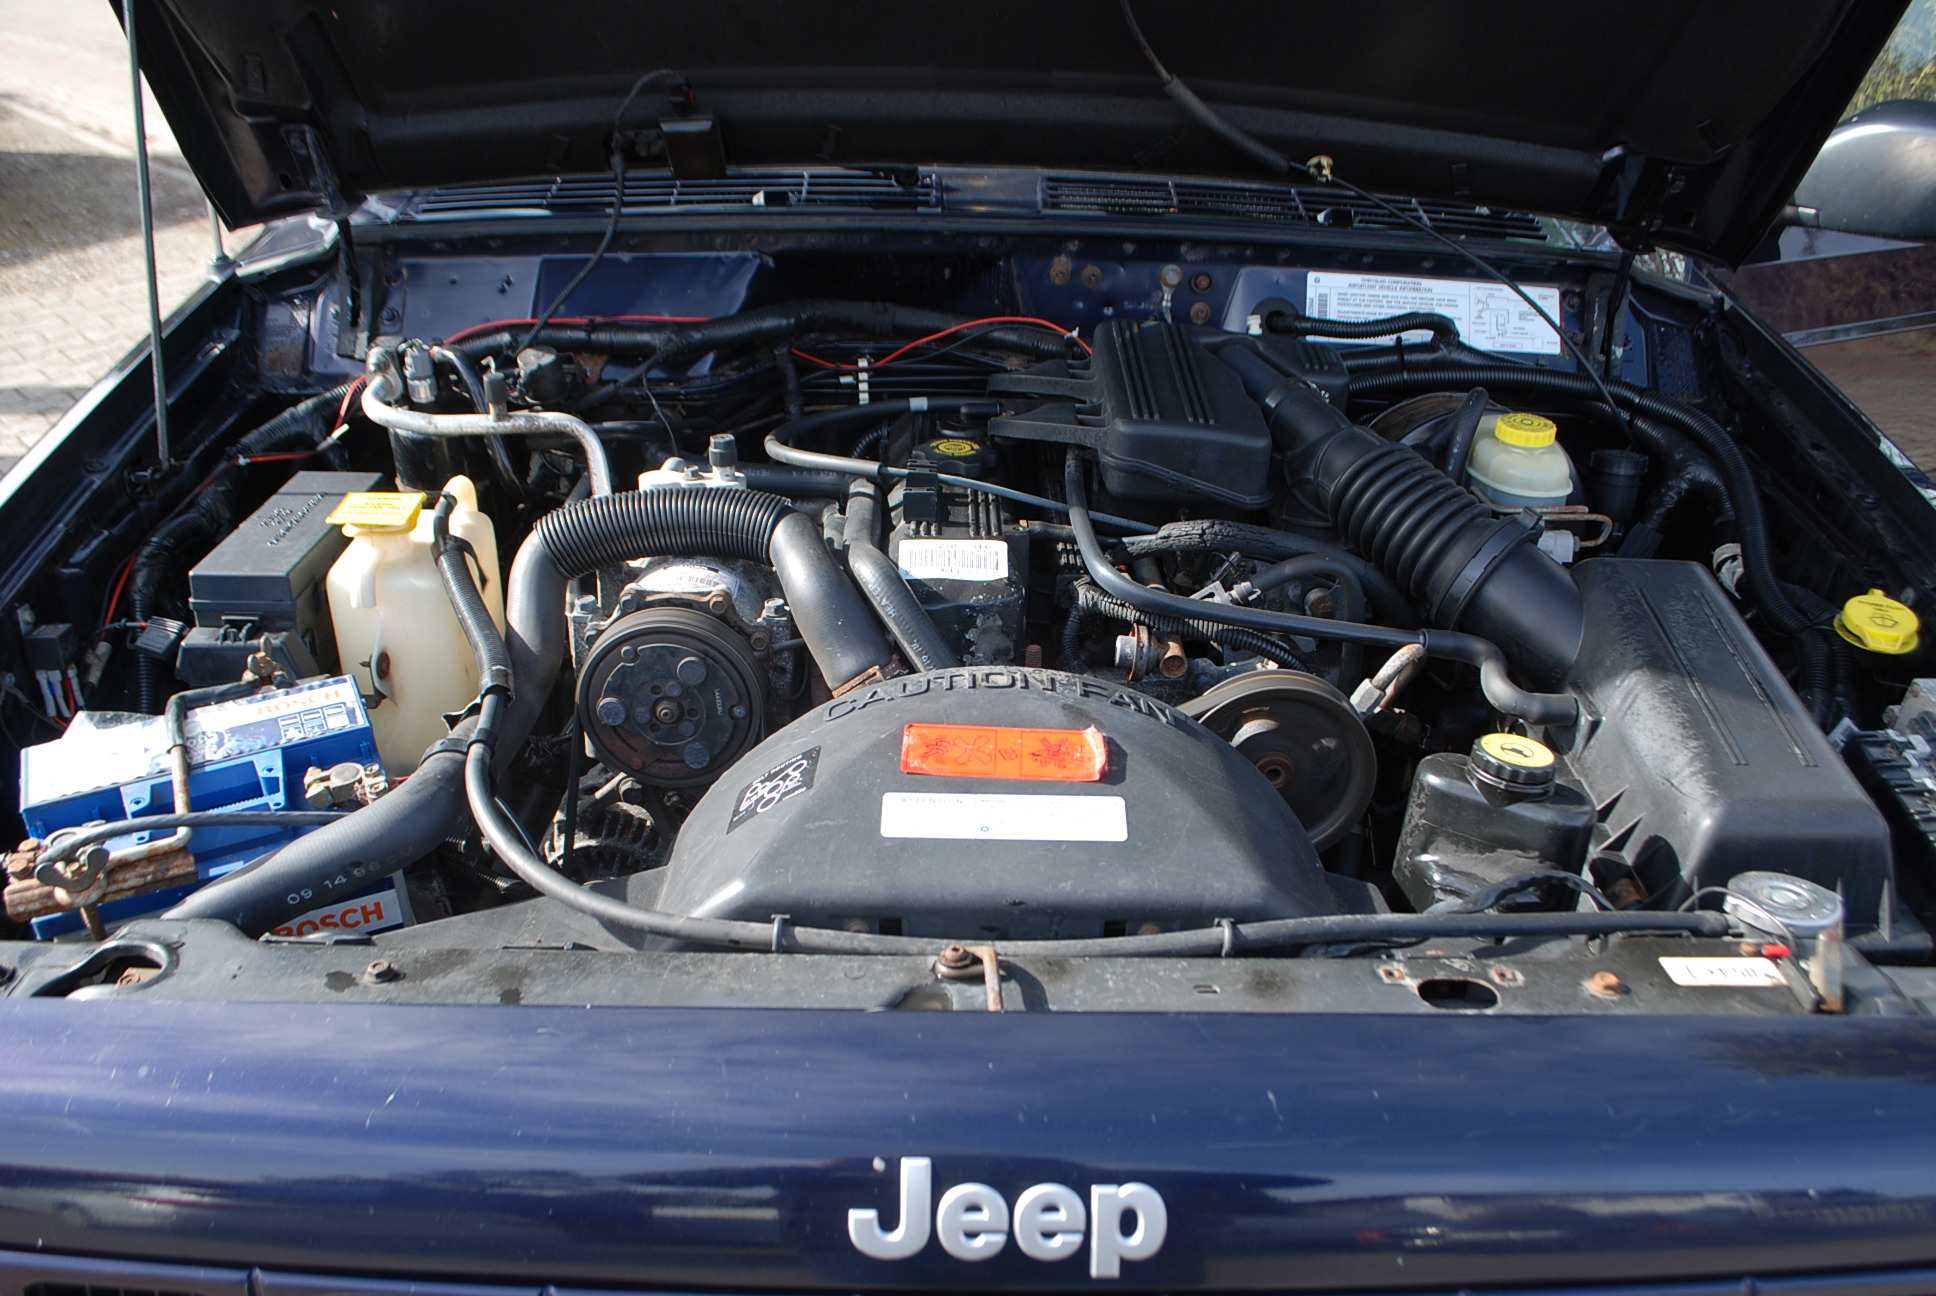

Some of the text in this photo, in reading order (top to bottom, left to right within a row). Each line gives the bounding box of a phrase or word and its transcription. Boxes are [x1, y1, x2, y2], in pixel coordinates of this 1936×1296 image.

[868, 584, 898, 618] HEATER
[257, 689, 341, 716] BOSCH
[824, 671, 1178, 726] CAUTION FAN
[286, 888, 313, 905] 09
[323, 874, 348, 889] 14
[353, 861, 381, 878] 98
[848, 1156, 1168, 1279] Jeep
